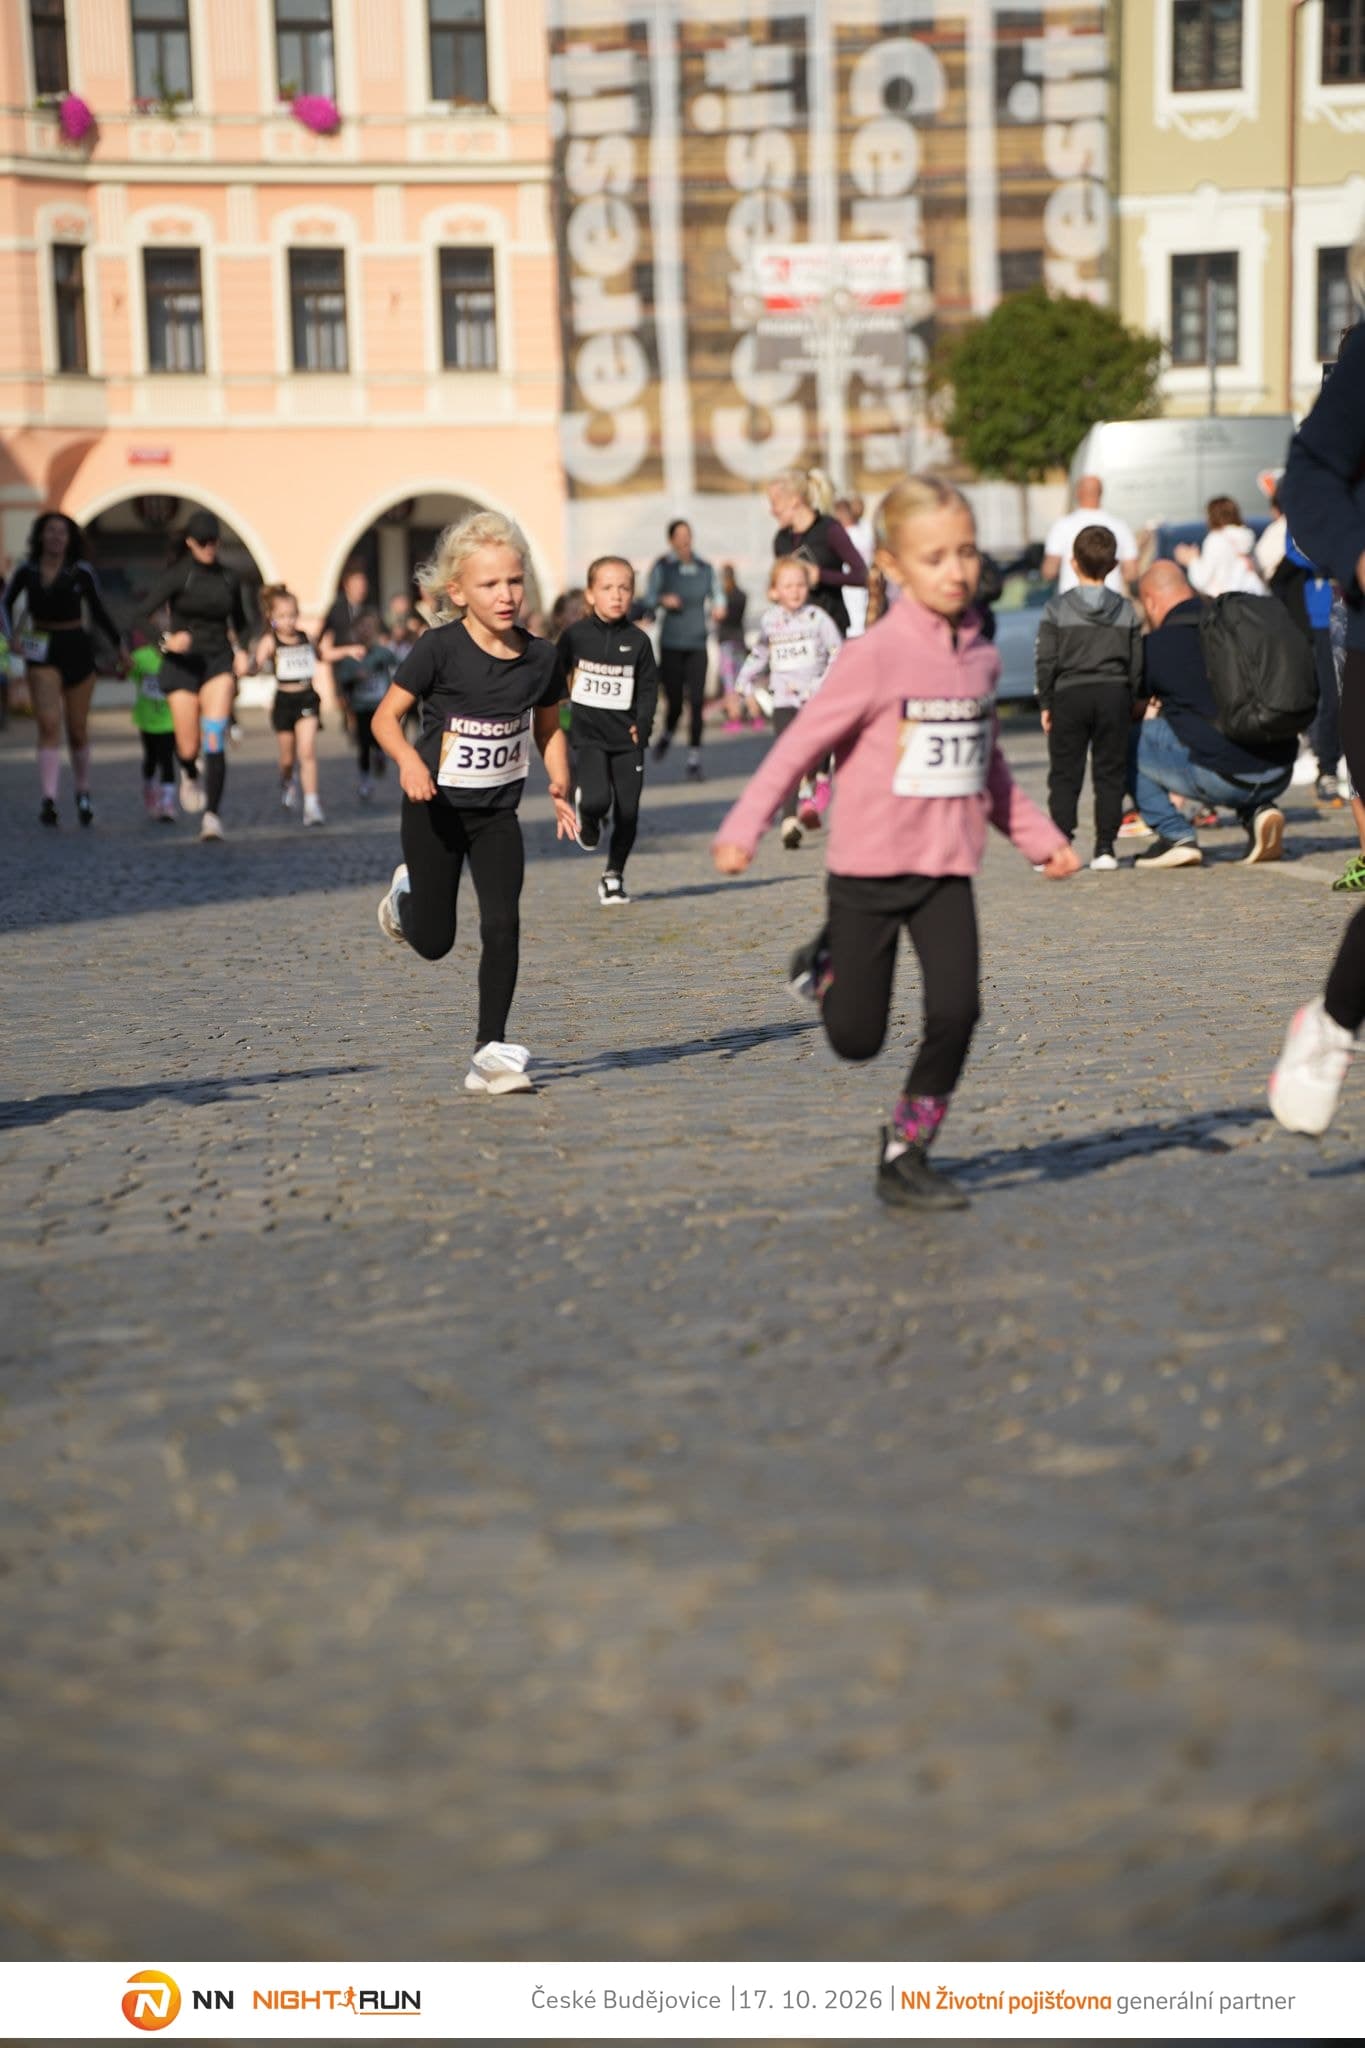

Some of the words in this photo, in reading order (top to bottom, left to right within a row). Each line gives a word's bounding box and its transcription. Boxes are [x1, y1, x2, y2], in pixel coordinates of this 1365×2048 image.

[549, 42, 649, 485] Ceresit
[583, 677, 622, 696] 3193
[449, 717, 521, 737] KIDSCUP
[457, 740, 522, 769] 3304
